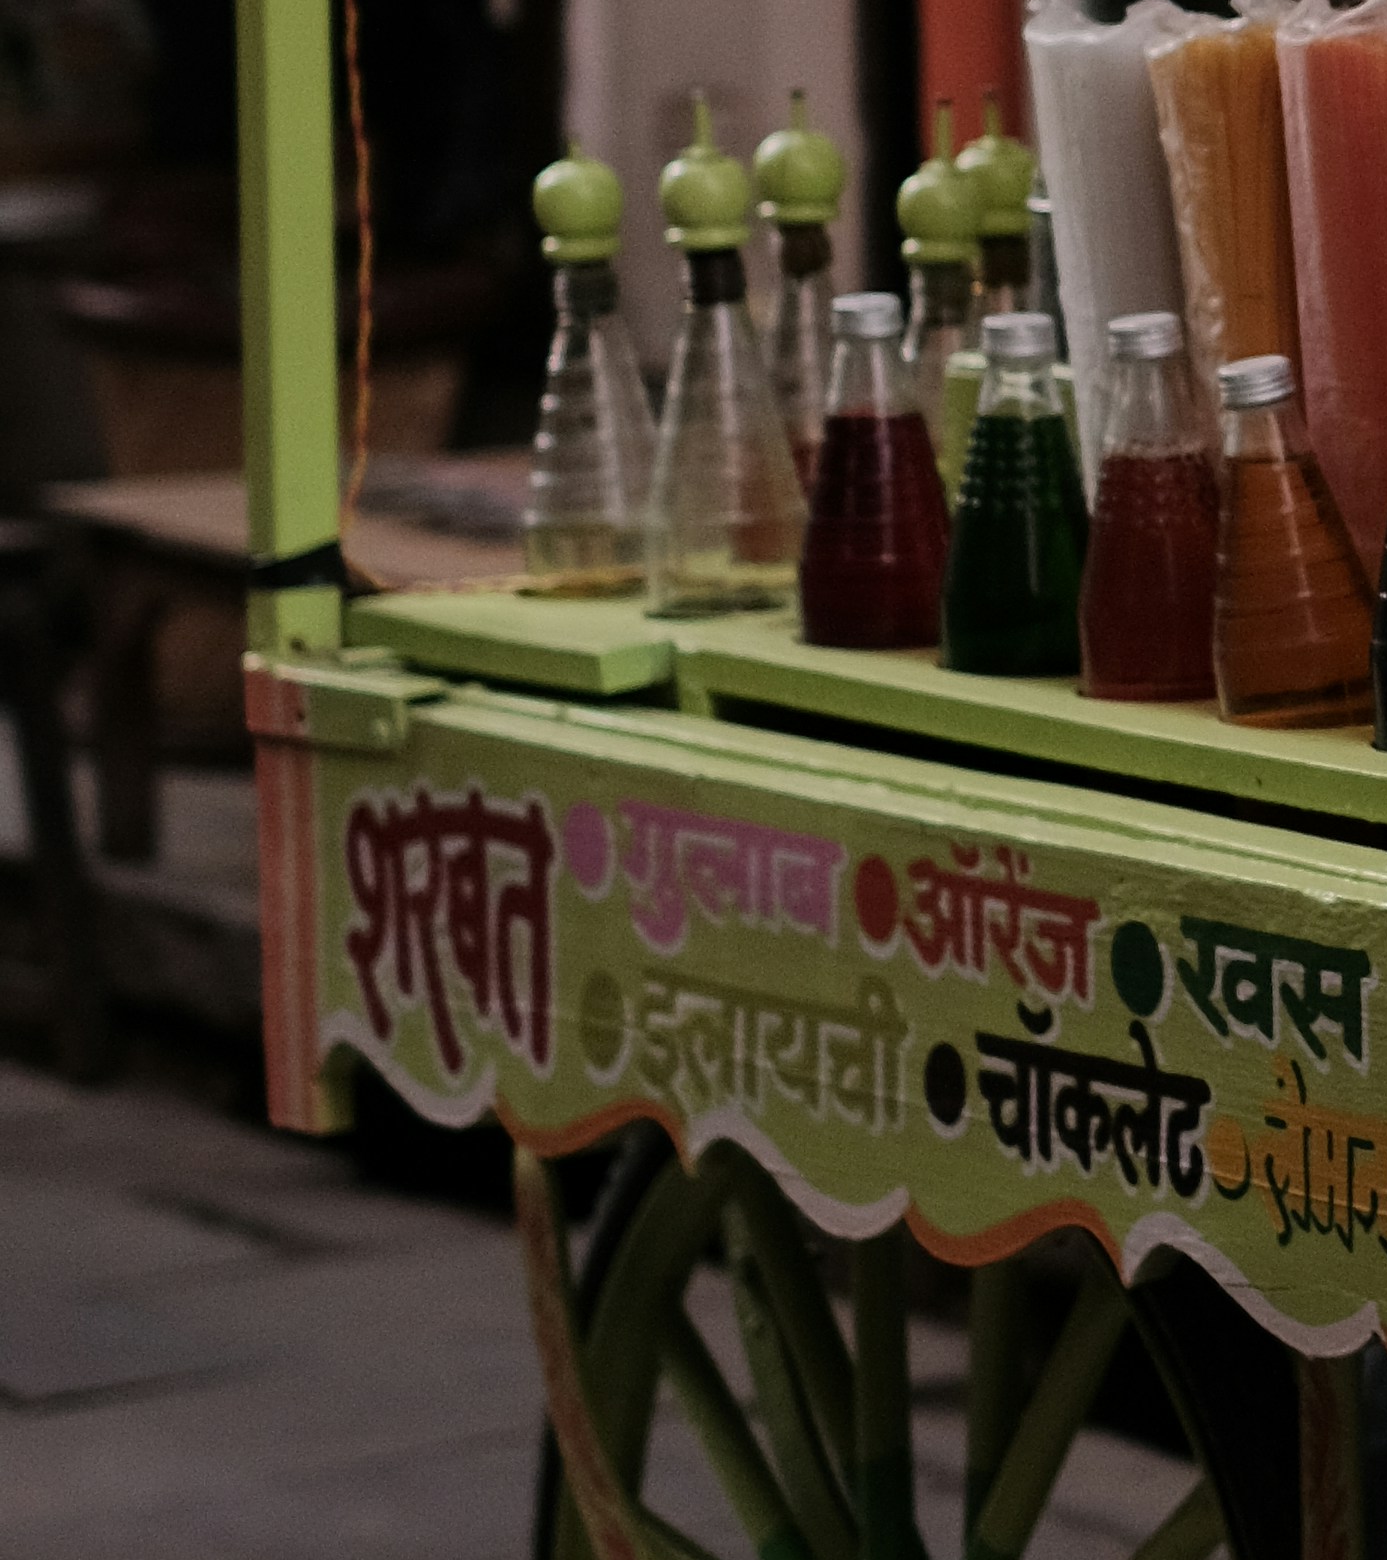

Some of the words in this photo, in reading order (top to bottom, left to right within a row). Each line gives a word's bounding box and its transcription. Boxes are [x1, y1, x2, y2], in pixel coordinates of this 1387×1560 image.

[345, 786, 553, 1077] शरबत
[618, 797, 848, 955] गुलाब
[1176, 916, 1372, 1062] खस
[641, 972, 908, 1135] इलायची
[975, 999, 1212, 1200] चॉकलेट
